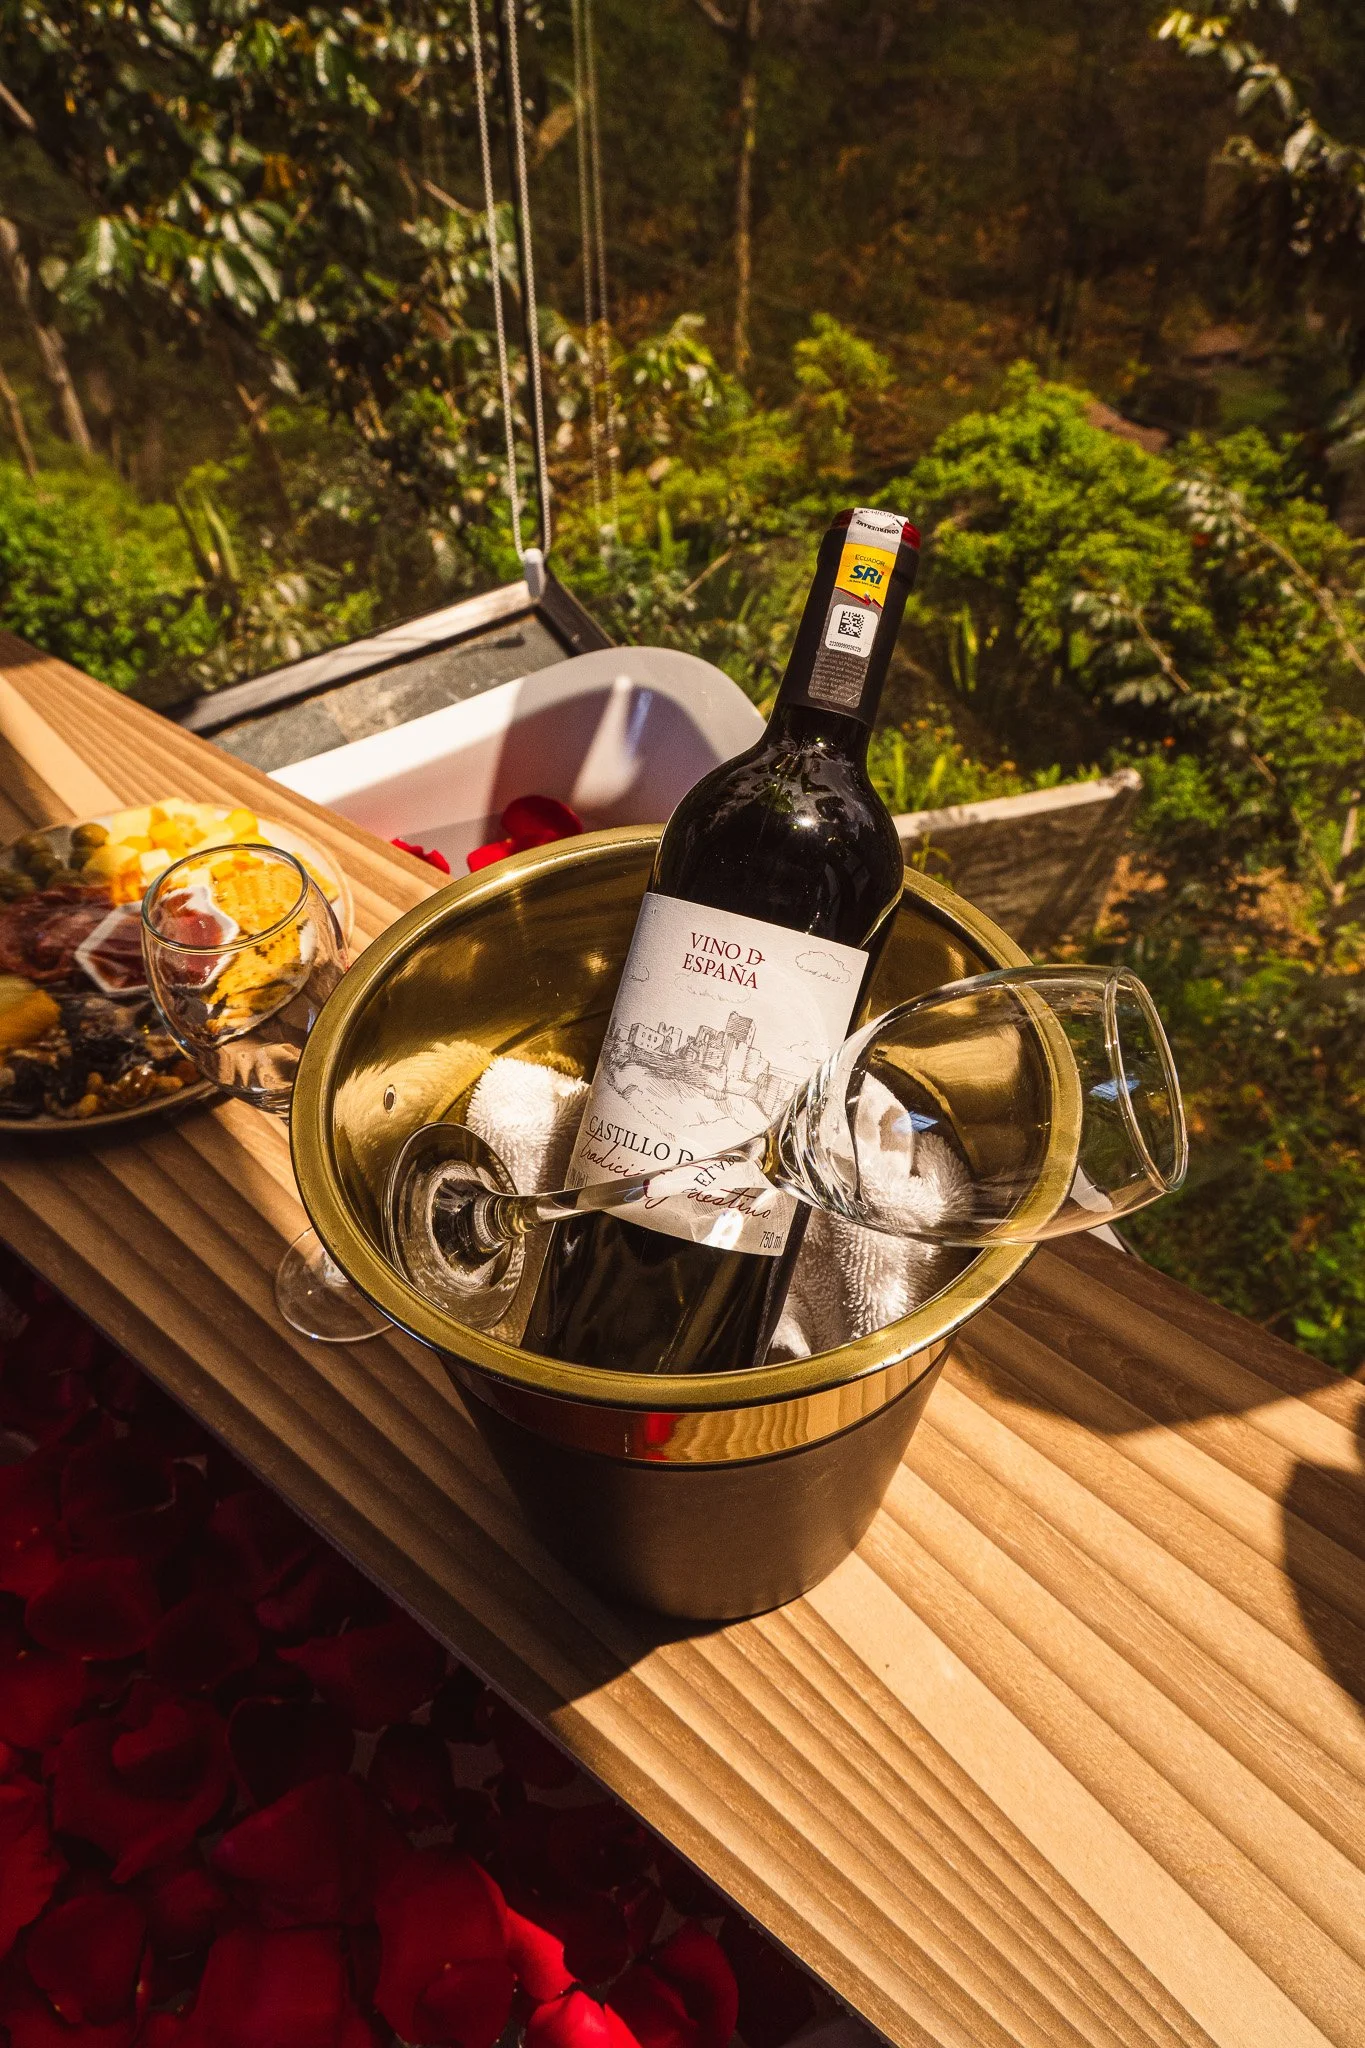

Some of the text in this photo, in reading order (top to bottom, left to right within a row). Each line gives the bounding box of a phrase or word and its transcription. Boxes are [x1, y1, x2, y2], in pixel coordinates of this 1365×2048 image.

[855, 553, 886, 566] ECUADOR
[690, 931, 741, 960] VINO
[681, 952, 758, 989] ESPAÑA
[589, 1115, 671, 1161] CASTILLO
[758, 1230, 775, 1249] 750
